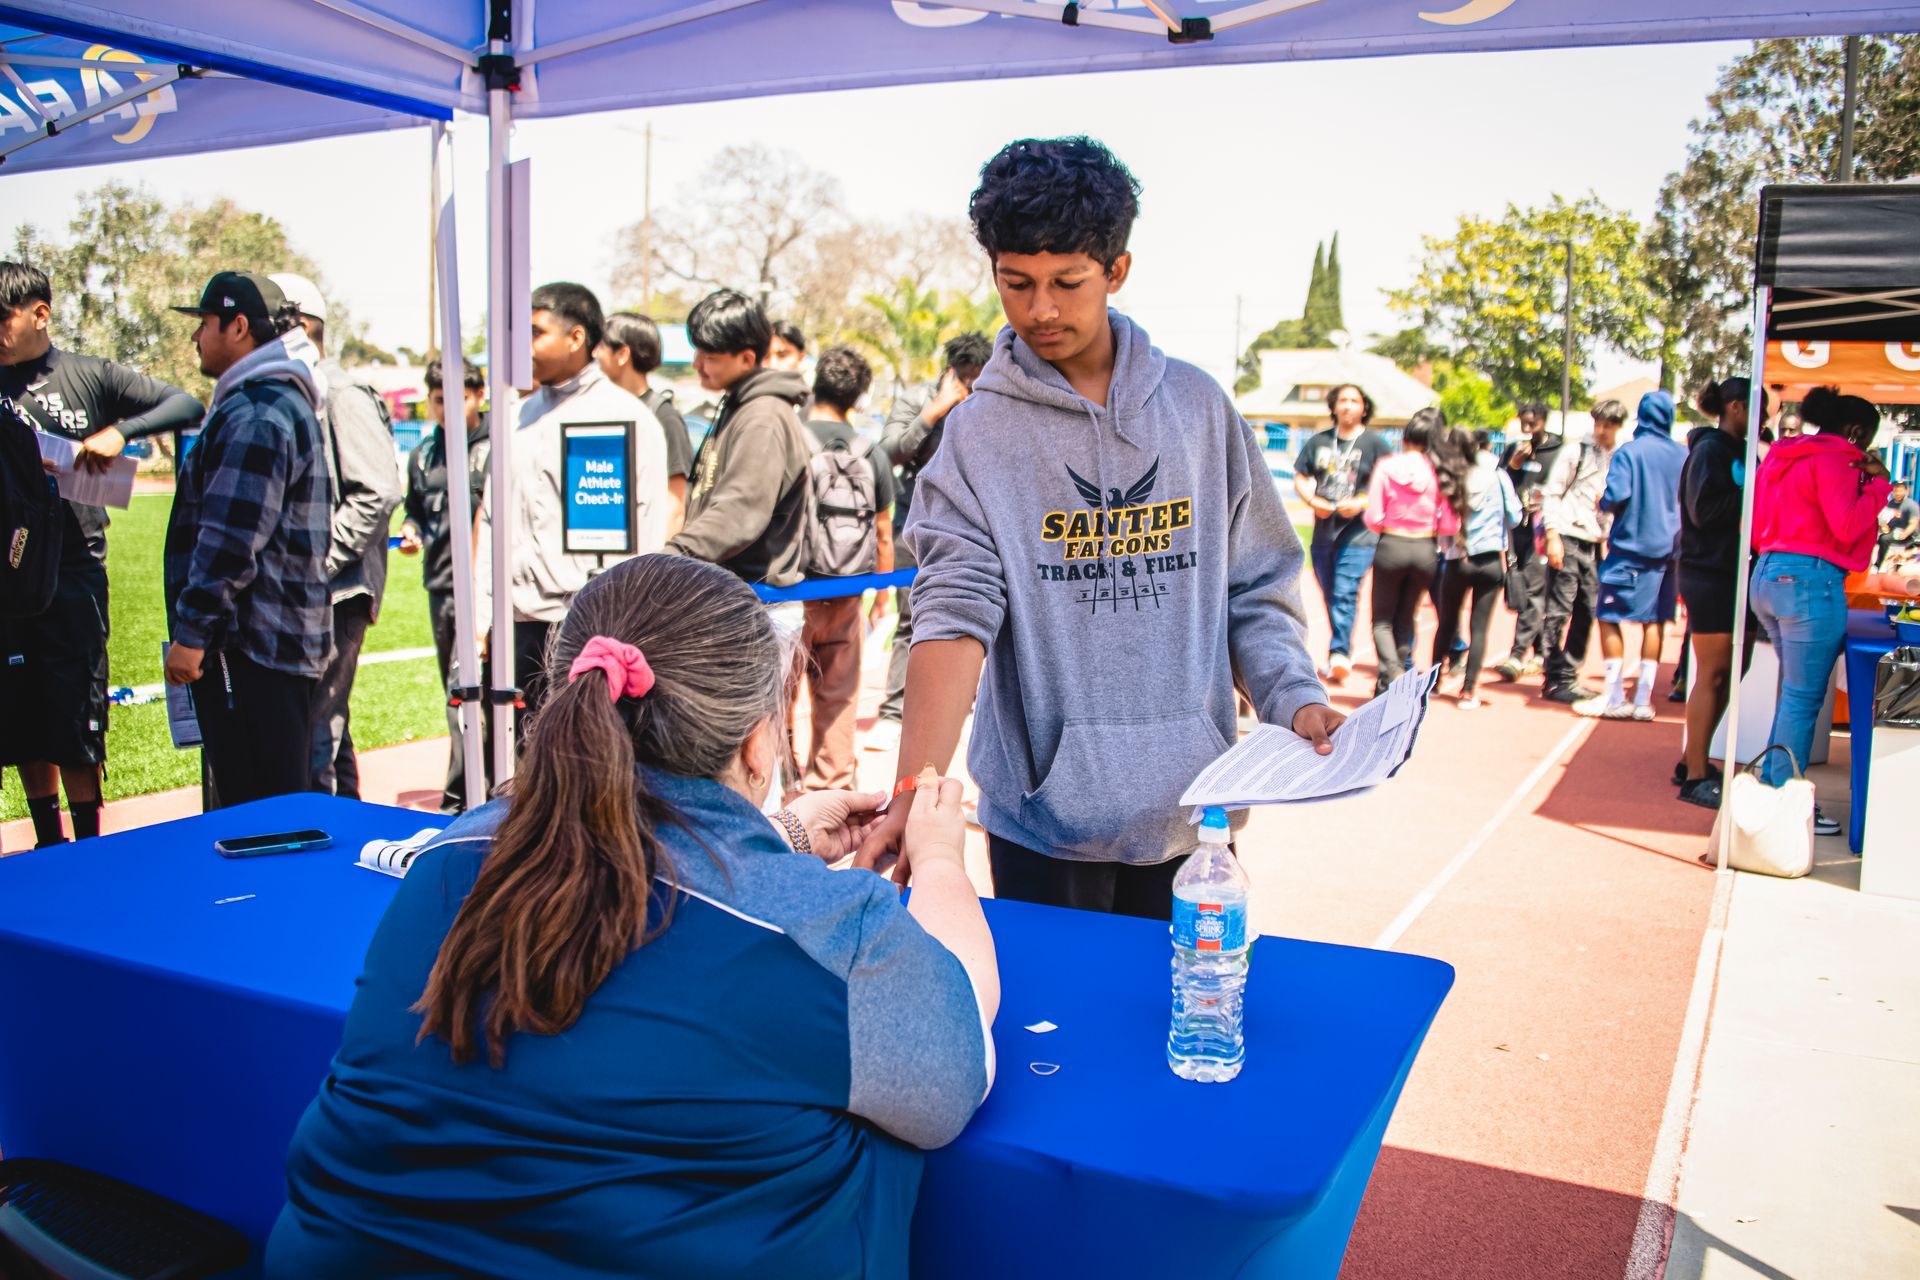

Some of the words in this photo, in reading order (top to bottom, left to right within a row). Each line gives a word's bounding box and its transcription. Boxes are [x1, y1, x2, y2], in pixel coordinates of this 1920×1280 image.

[585, 459, 614, 473] Male
[578, 475, 621, 489] Athlete
[574, 491, 624, 505] Check-In
[1041, 497, 1191, 542] SANTEE
[1121, 561, 1137, 577] &
